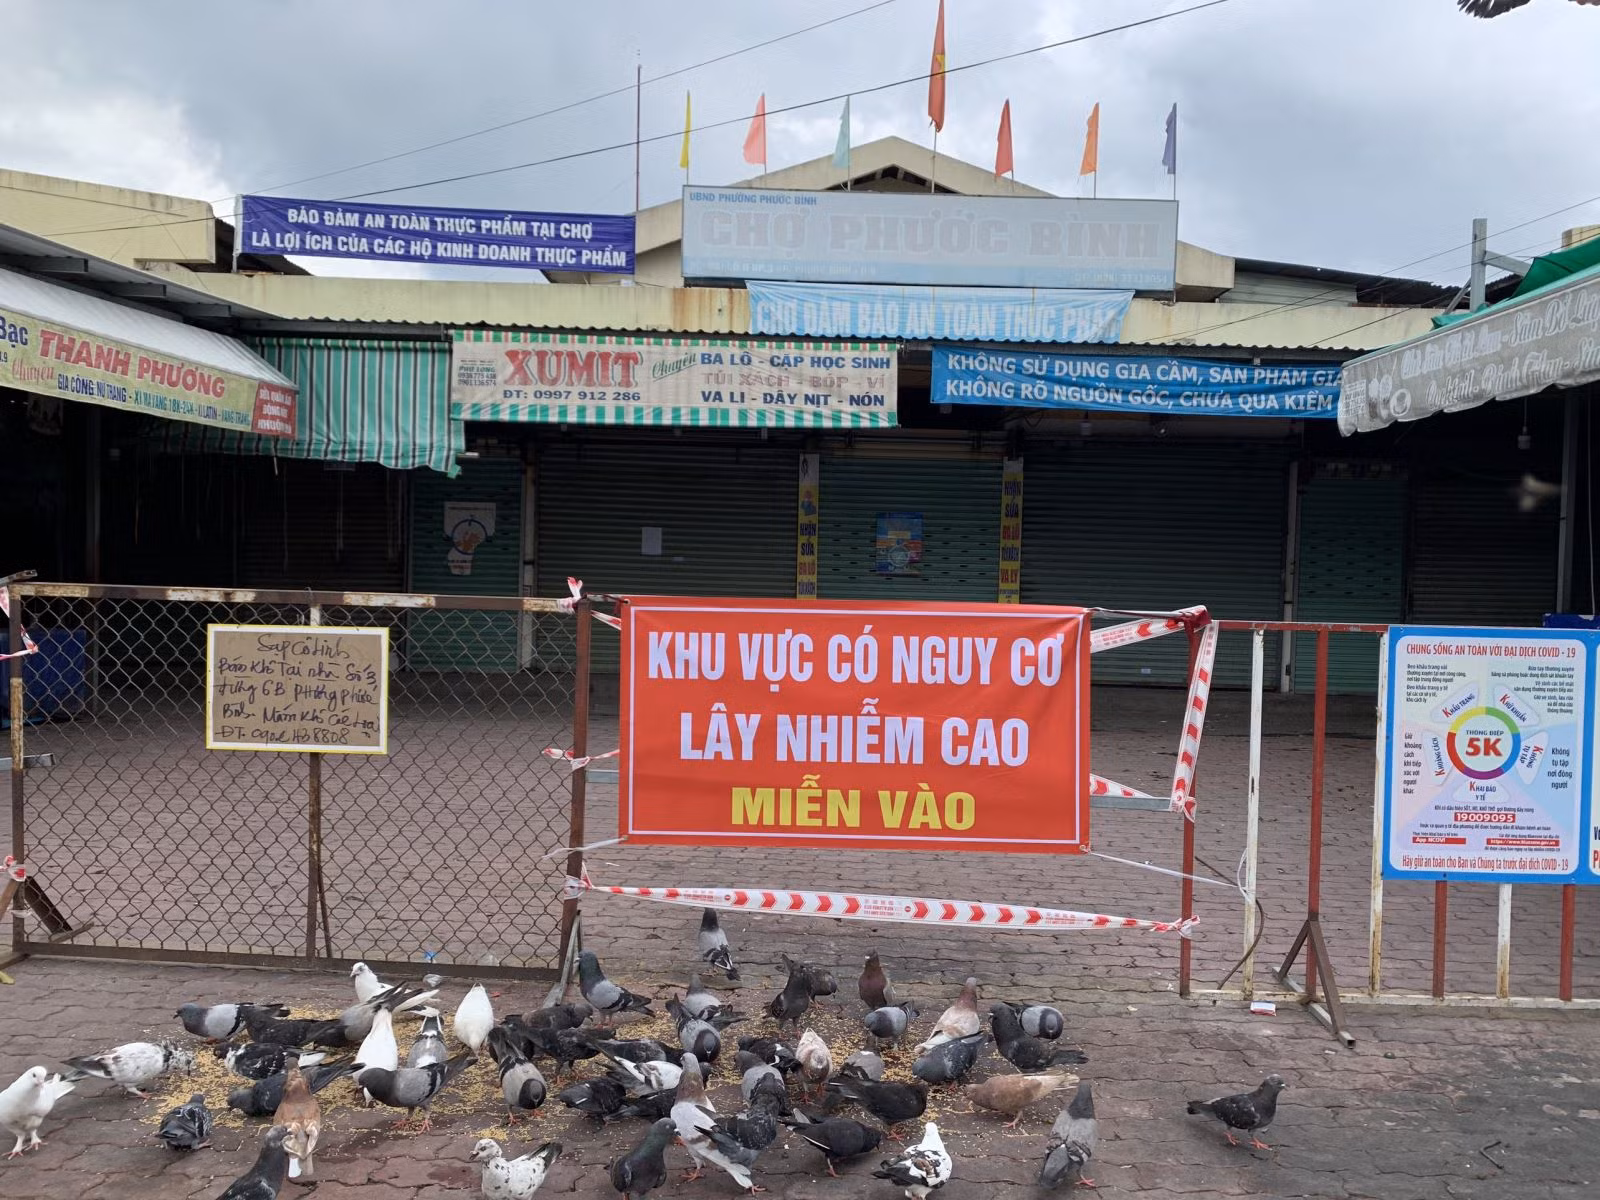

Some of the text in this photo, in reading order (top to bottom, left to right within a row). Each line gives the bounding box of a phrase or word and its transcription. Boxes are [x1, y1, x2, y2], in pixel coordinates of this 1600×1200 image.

[690, 192, 715, 201] UBND
[287, 206, 593, 243] BẢO ĐẢM AN TOÀN THỰC PHẨM TẠI CHỢ
[252, 229, 626, 267] LÀ LỢI ÍCH CỦA CÁC HỘ KINH DOANH THỰC PHẨM
[40, 328, 132, 377] THANH
[137, 354, 225, 398] PHƯƠNG
[504, 349, 643, 388] XUMIT
[701, 351, 891, 371] BA LÔ CẶP HỌC SINH
[948, 352, 1016, 374] KHÔNG
[1021, 355, 1049, 375] SỬ
[1054, 360, 1109, 381] DỤNG
[1115, 362, 1150, 379] GIA
[1156, 360, 1202, 385] CẦM,
[58, 373, 69, 391] GIA
[71, 374, 94, 396] CÔNG
[106, 383, 127, 403] TRANG
[503, 389, 641, 401] ĐT: 0997 912 286
[701, 390, 884, 408] VA LI DÂY NỊT NÓN
[946, 375, 1015, 399] KHÔNG
[1020, 379, 1048, 400] RÕ
[1054, 382, 1122, 405] NGUỒN
[1128, 384, 1173, 409] GỐC,
[1179, 389, 1233, 409] CHƯA
[1238, 394, 1279, 413] QUA
[647, 624, 1065, 693] KHU VỰC CÓ NGUY CƠ
[1406, 642, 1576, 659] CHUNG SỐNG AN TOÀN VỚI ĐẠI DỊCH COVID 19
[1442, 693, 1475, 718] KHẨU TRANG
[680, 697, 1029, 767] LÂY NHIỄM CAO
[1465, 737, 1503, 757] 5K
[1469, 780, 1485, 791] KHAI
[731, 774, 976, 831] MIỄN VÀO
[1456, 813, 1514, 822] 19009095
[1402, 854, 1413, 868] Hãy
[1424, 857, 1432, 867] an
[1432, 856, 1446, 868] toàn
[1447, 856, 1457, 868] cho
[1495, 858, 1501, 869] ta
[1541, 858, 1557, 870] COVID
[1561, 858, 1569, 871] 19
